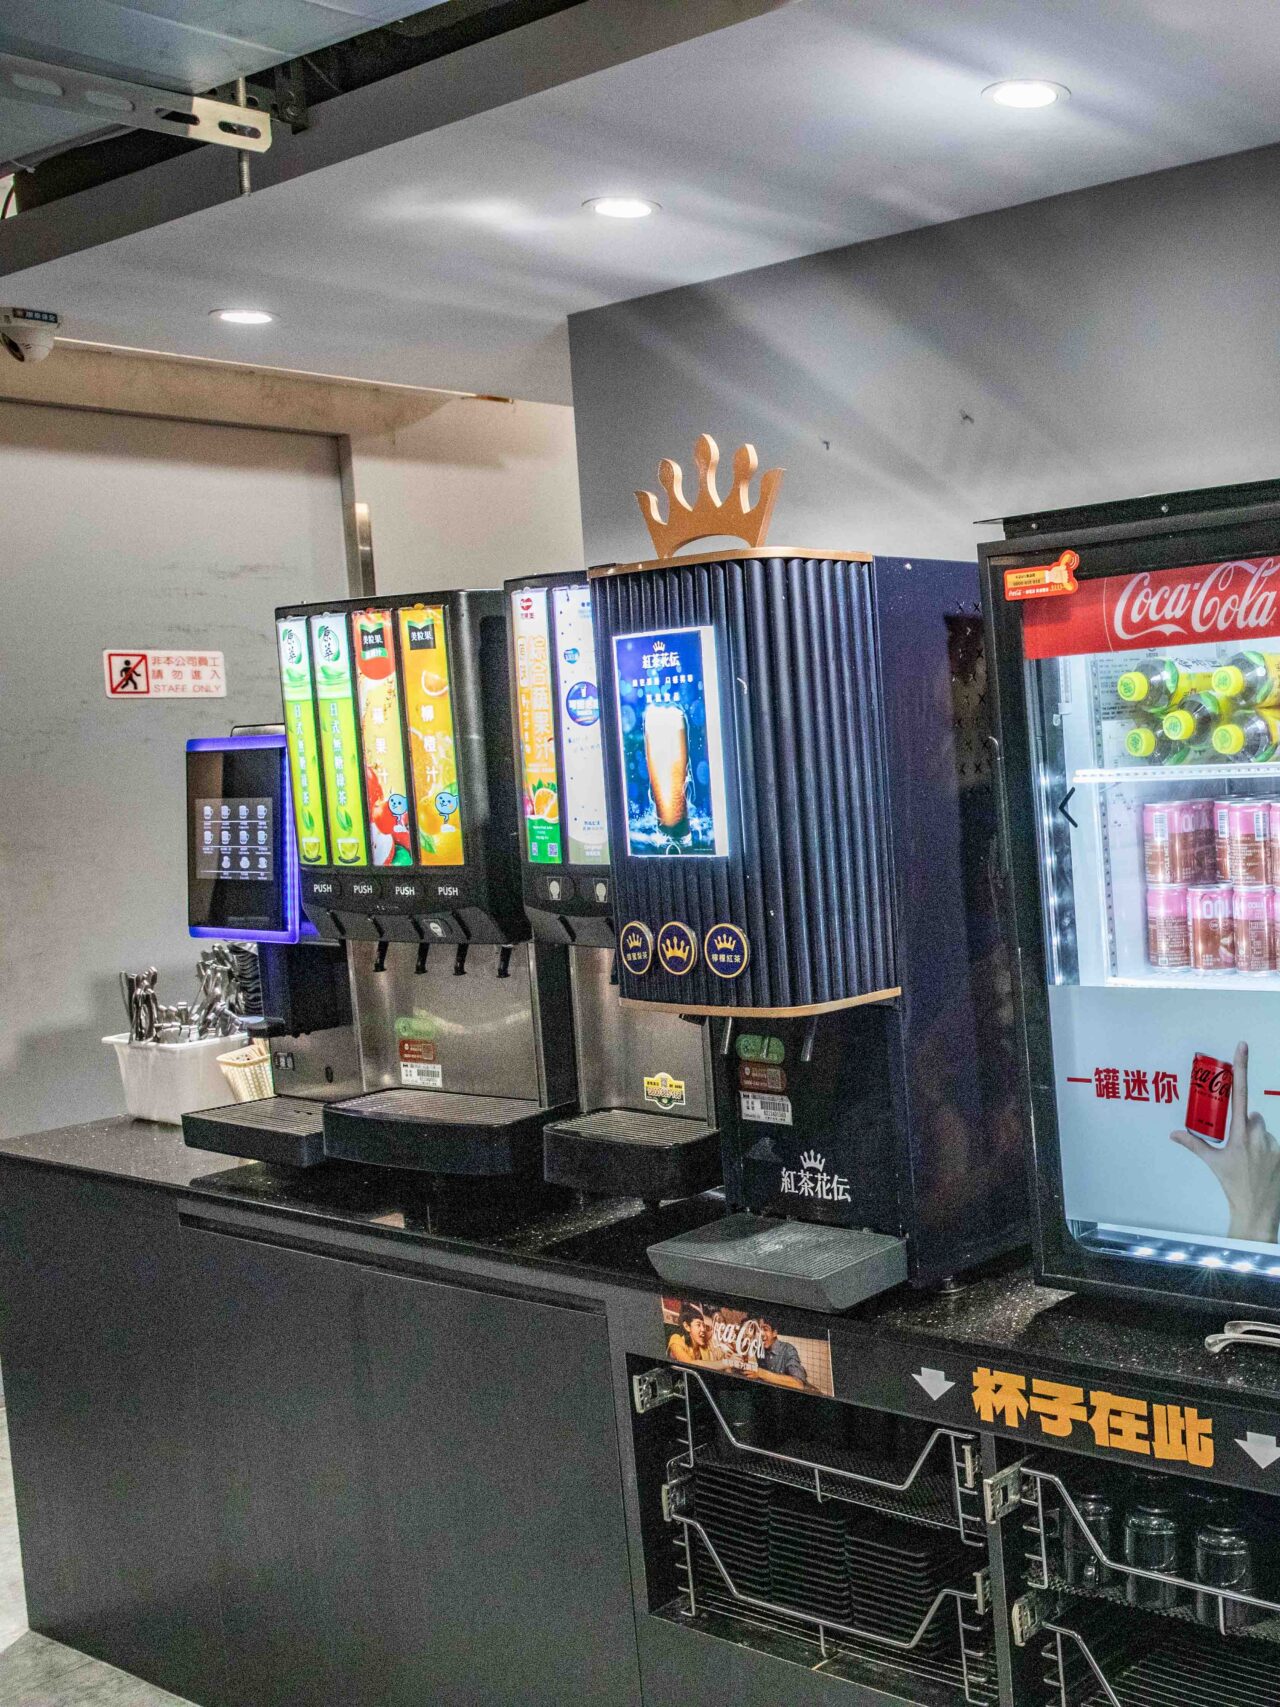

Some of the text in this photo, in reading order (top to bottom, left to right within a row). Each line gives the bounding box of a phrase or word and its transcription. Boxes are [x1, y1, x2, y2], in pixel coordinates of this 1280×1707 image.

[151, 656, 221, 667] 非本公司員工
[152, 669, 221, 680] 請勿進入
[192, 684, 221, 693] ONLY
[314, 884, 332, 893] PUSH
[353, 885, 372, 894] PUSH
[395, 886, 415, 896] PUSH
[438, 886, 458, 896] PUSH
[1067, 1067, 1179, 1103] 一罐迷你
[780, 1167, 851, 1201] 紅茶花伝
[971, 1366, 1215, 1468] 杯子在此
